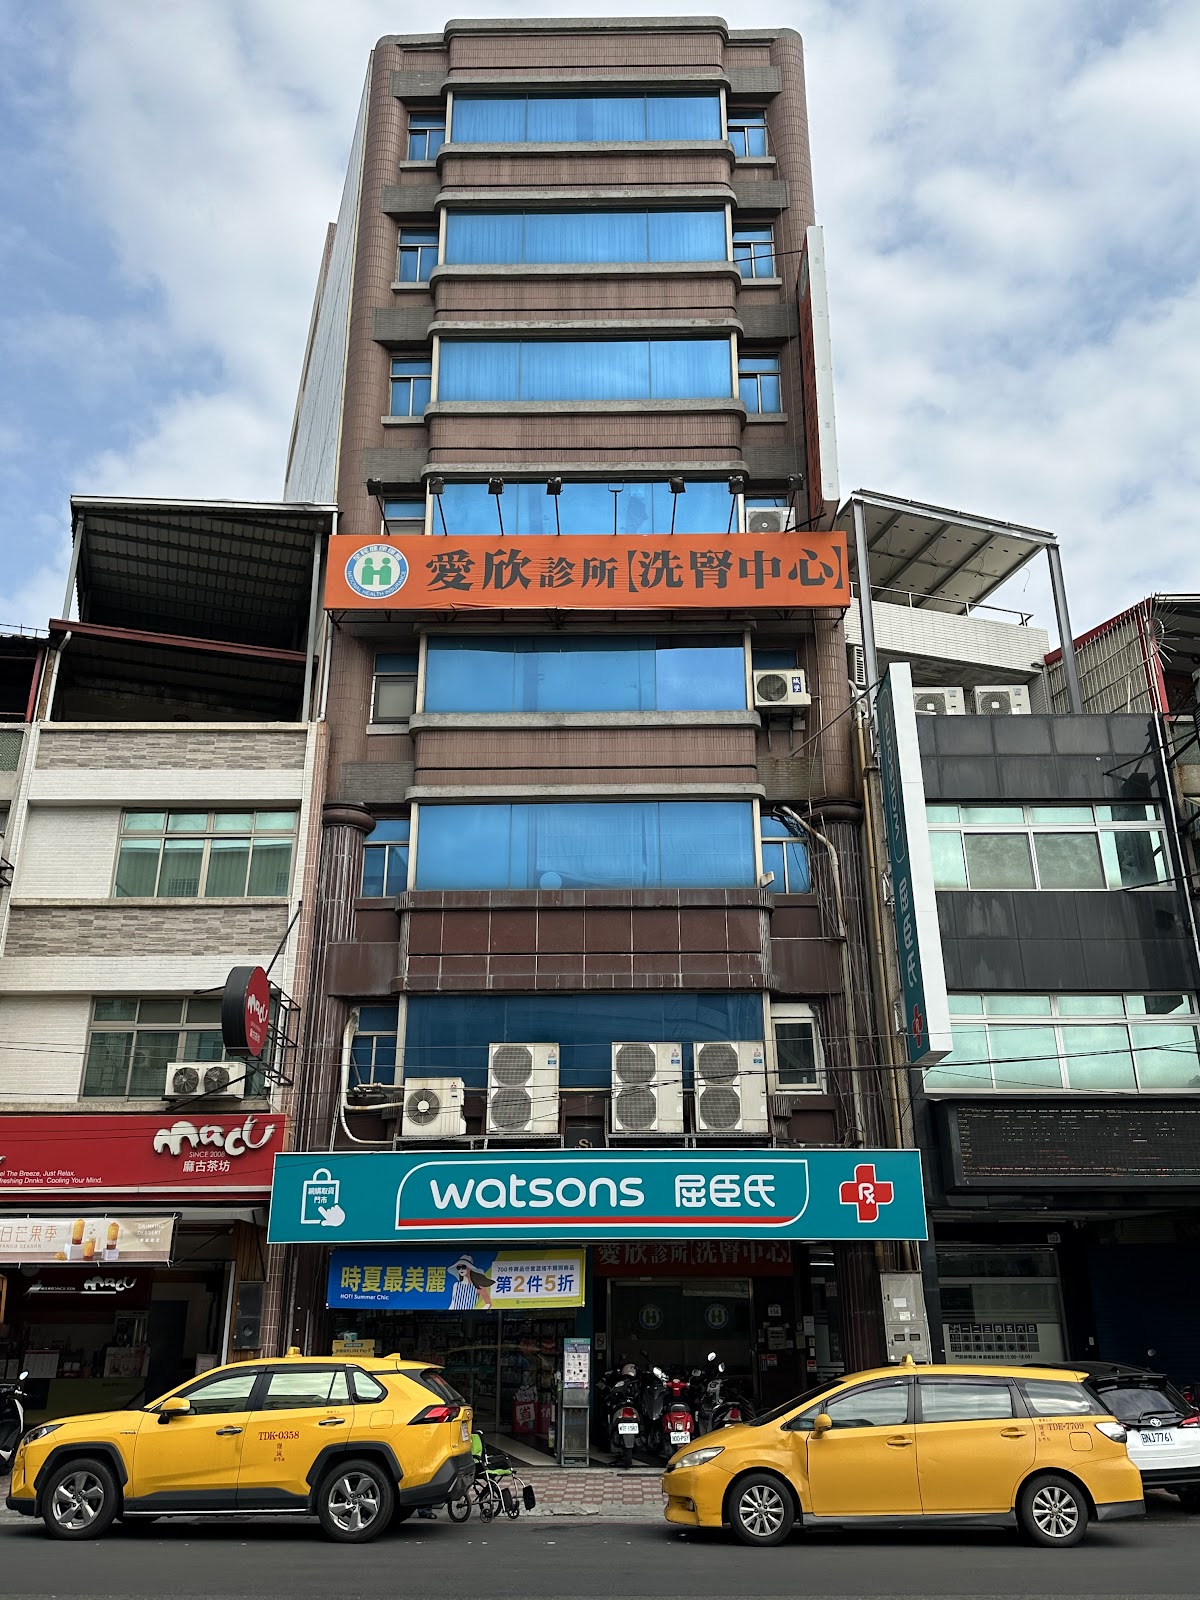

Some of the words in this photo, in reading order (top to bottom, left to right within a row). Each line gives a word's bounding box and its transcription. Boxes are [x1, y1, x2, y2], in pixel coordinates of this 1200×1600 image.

[183, 1160, 230, 1172] 麻古茶坊
[47, 1177, 69, 1185] Cooling
[429, 1173, 645, 1209] watsons
[675, 1174, 776, 1208] 屈臣氏
[341, 1266, 446, 1293] 時夏最美麗
[496, 1274, 574, 1293] 第2件5折
[1047, 1422, 1084, 1431] TDE-7709
[258, 1431, 300, 1440] TDK-0358
